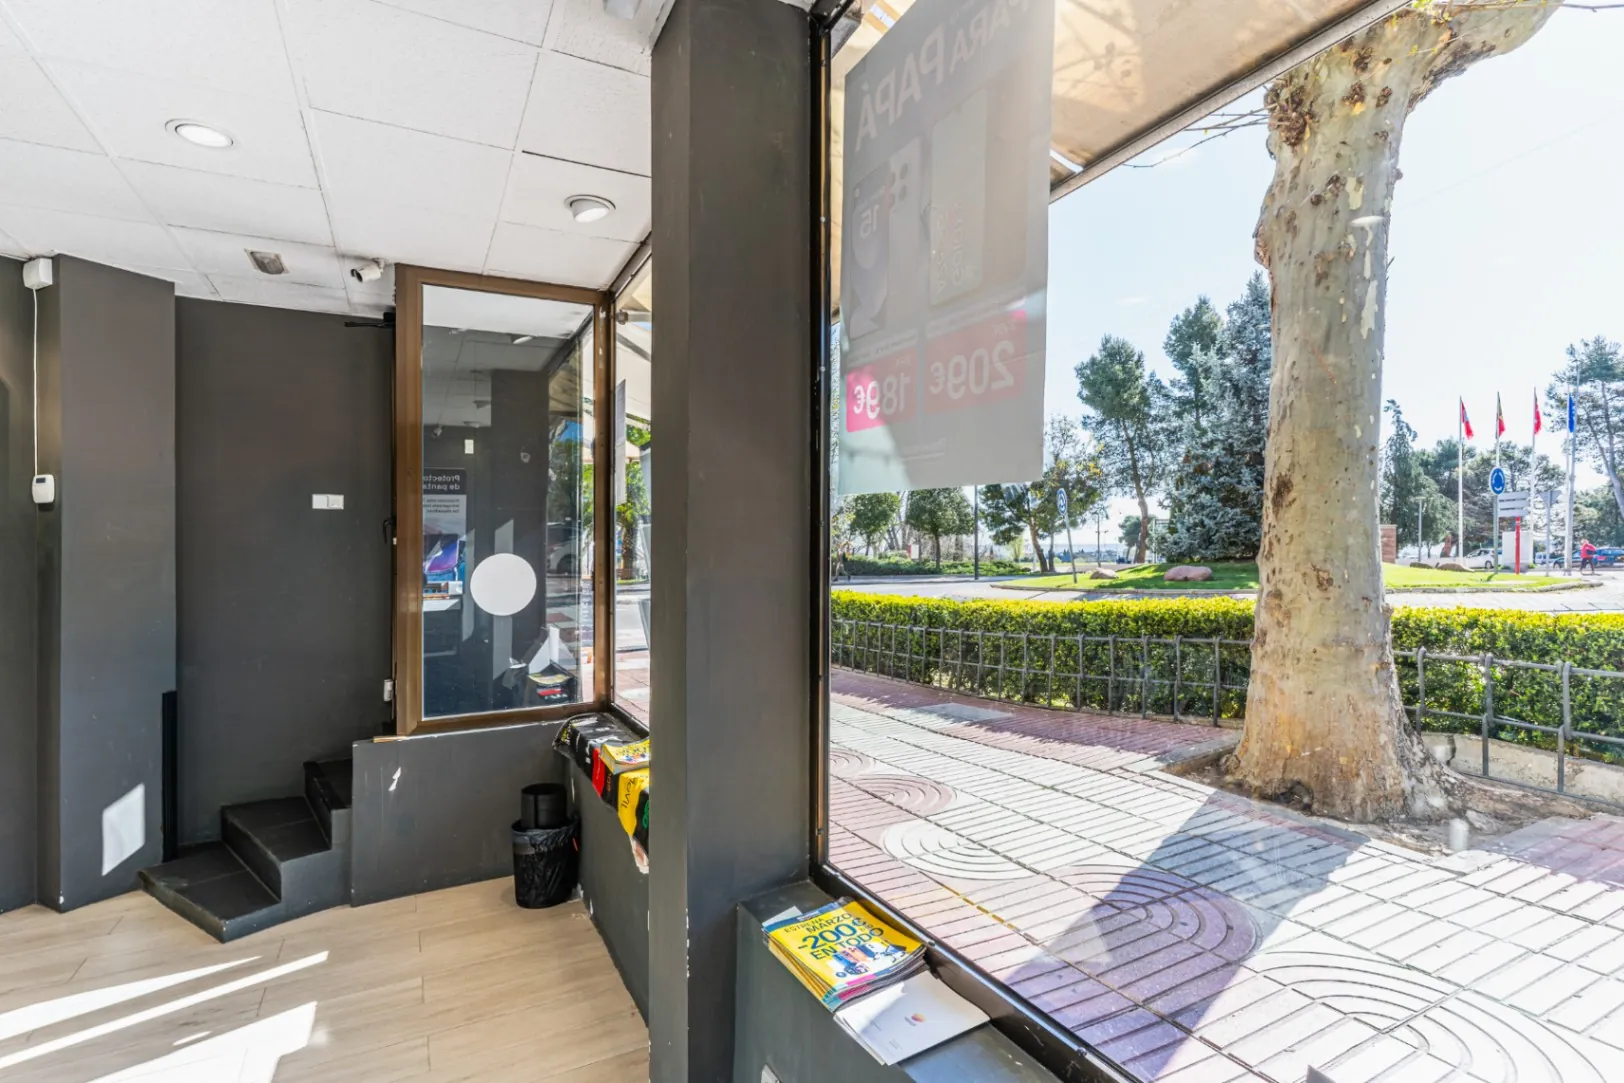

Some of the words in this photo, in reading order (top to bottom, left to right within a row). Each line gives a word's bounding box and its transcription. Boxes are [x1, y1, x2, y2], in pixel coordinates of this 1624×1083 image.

[807, 913, 853, 933] MARZO
[810, 945, 838, 960] EN
[836, 927, 884, 948] TODO
